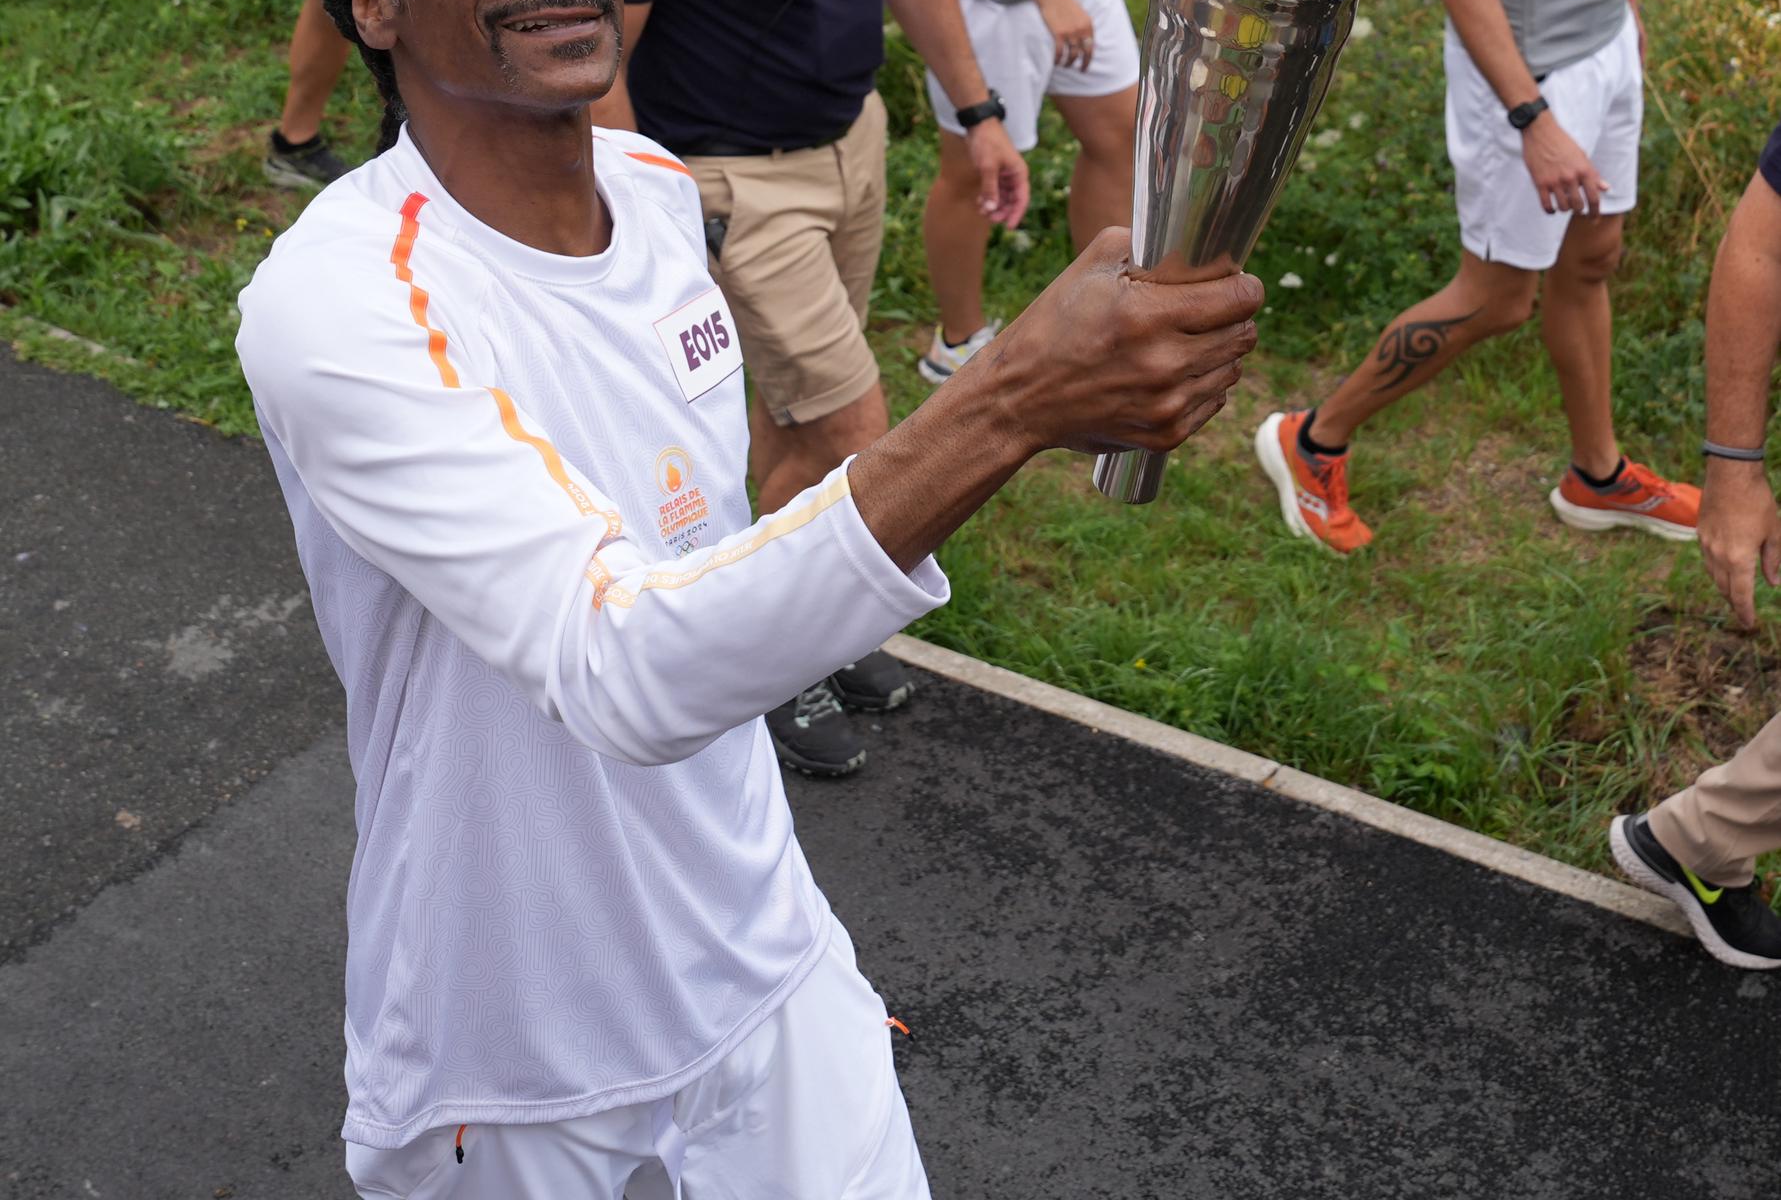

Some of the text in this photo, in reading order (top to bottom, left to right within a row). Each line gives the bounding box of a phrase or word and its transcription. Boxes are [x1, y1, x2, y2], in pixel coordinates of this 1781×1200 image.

[658, 496, 707, 528] LA FLAMME
[659, 487, 701, 515] RELAIS DE
[660, 506, 709, 538] OLYMPIQUE
[665, 520, 708, 546] PARIS 2024
